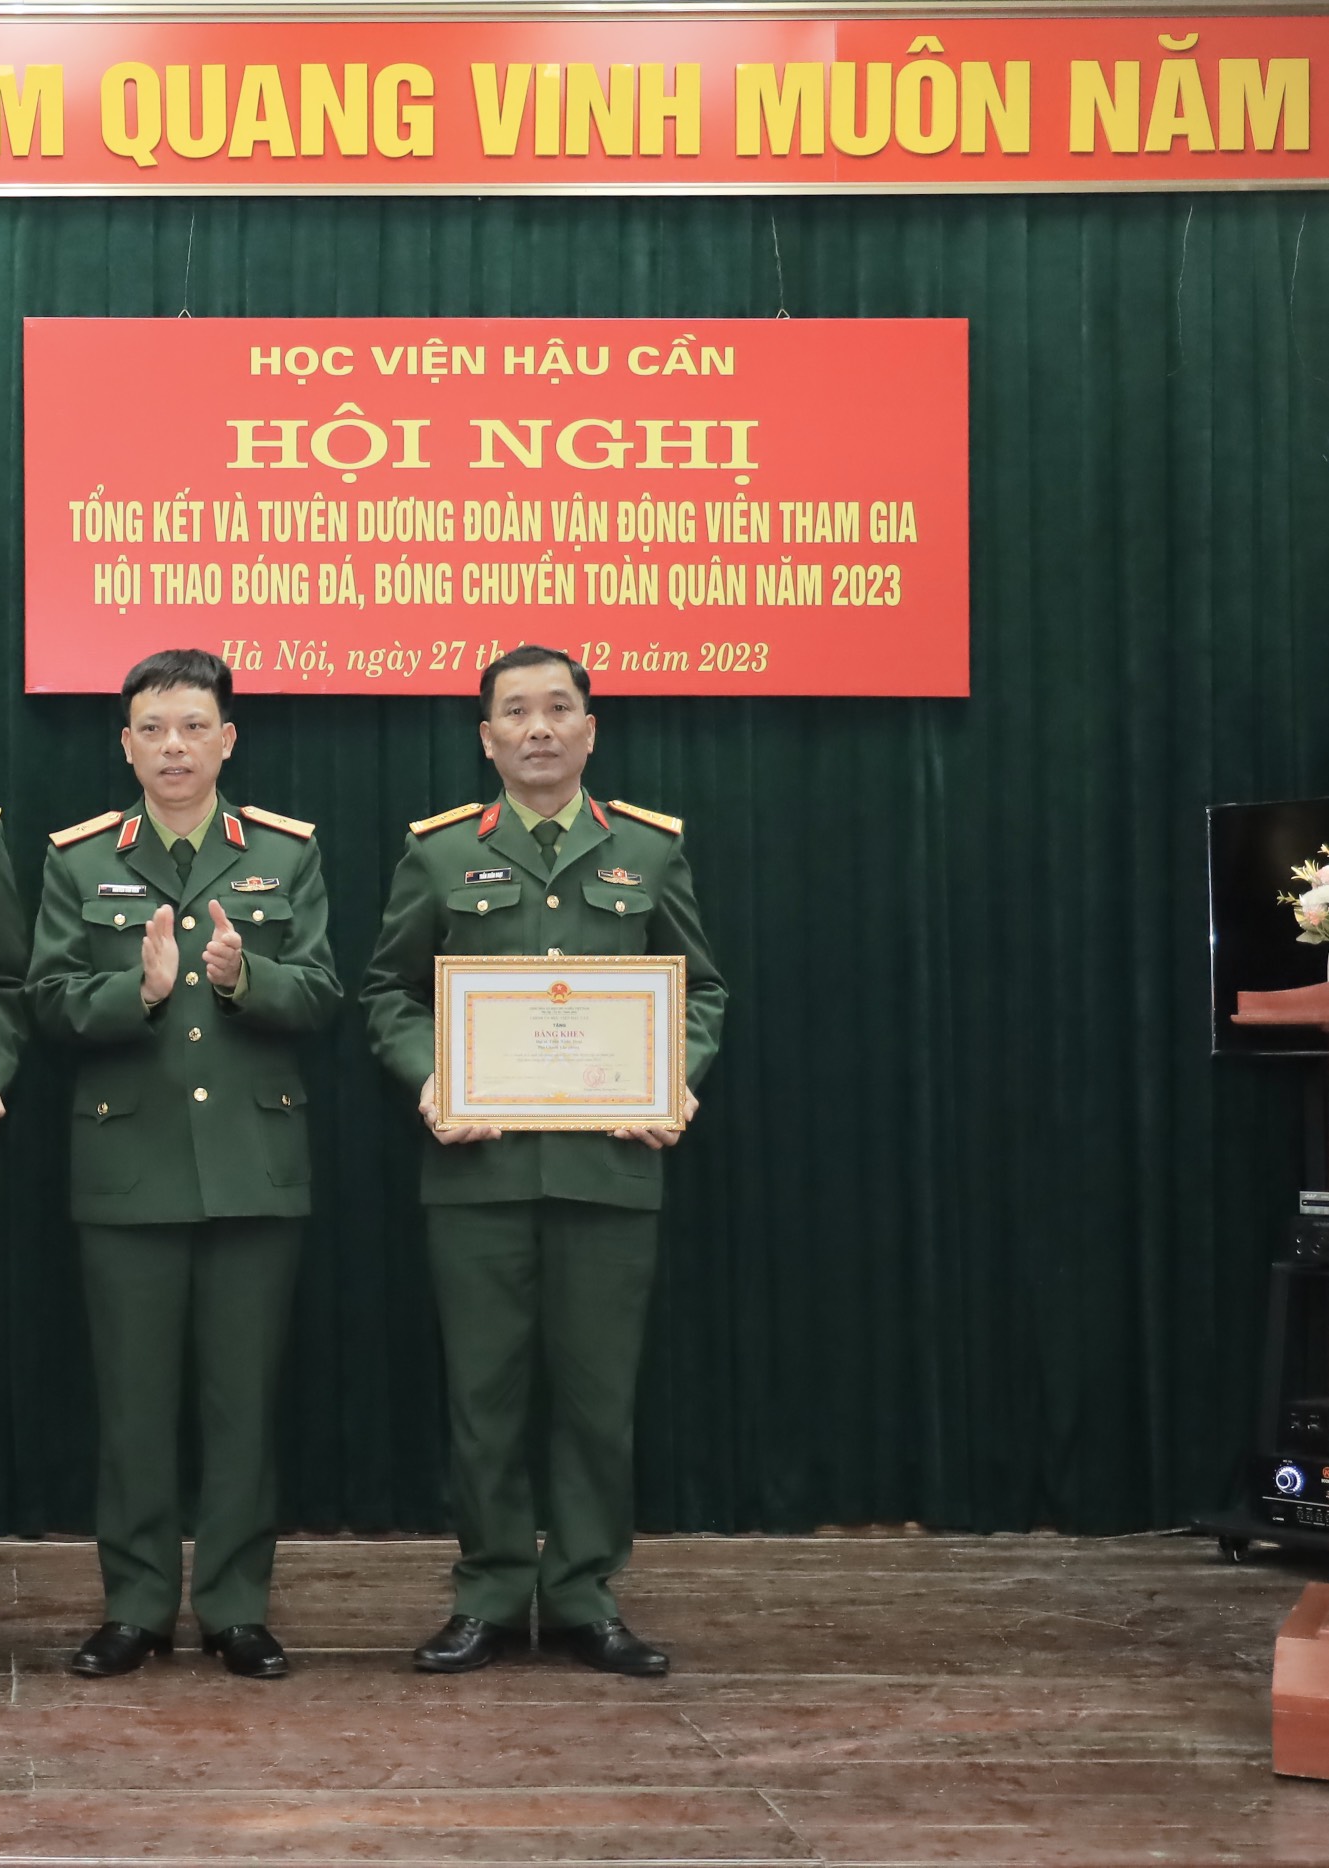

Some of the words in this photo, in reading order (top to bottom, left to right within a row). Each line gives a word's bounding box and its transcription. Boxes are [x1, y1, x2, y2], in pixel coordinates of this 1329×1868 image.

[99, 61, 435, 167] QUANG
[471, 62, 701, 157] VINH
[736, 35, 1032, 156] MUÔN
[1070, 32, 1311, 153] NĂM
[250, 345, 354, 385] HỌC
[371, 337, 487, 385] VIỆN
[504, 337, 611, 385] HẬU
[628, 333, 736, 377] CẦN
[226, 402, 432, 484] HỘI
[469, 418, 760, 486] NGHỊ
[69, 484, 144, 543] TỔNG
[153, 487, 205, 543] KẾT
[213, 492, 250, 543] VÀ
[258, 492, 348, 543] TUYÊN
[357, 496, 455, 543] DƯƠNG
[463, 492, 542, 543] ĐOÀN
[551, 492, 608, 552] VẬN
[617, 492, 696, 553] ĐỘNG
[705, 492, 770, 544] VIÊN
[779, 501, 860, 544] THAM
[869, 501, 918, 544] GIA
[94, 554, 141, 615] HỘI
[150, 563, 222, 606] THAO
[232, 554, 310, 606] BÓNG
[318, 554, 366, 610] ĐÁ,
[374, 554, 453, 606] BÓNG
[462, 549, 575, 606] CHUYỀN
[584, 555, 659, 606] TOÀN
[668, 555, 747, 611] QUÂN
[756, 555, 822, 606] NĂM
[832, 564, 901, 607] 2023
[222, 639, 263, 671] Hà
[273, 640, 336, 681] Nội,
[347, 640, 422, 678] ngày
[429, 640, 468, 671] 27
[579, 640, 612, 672] 12
[621, 641, 691, 672] năm
[698, 643, 770, 674] 2023
[560, 1030, 585, 1038] KHEN
